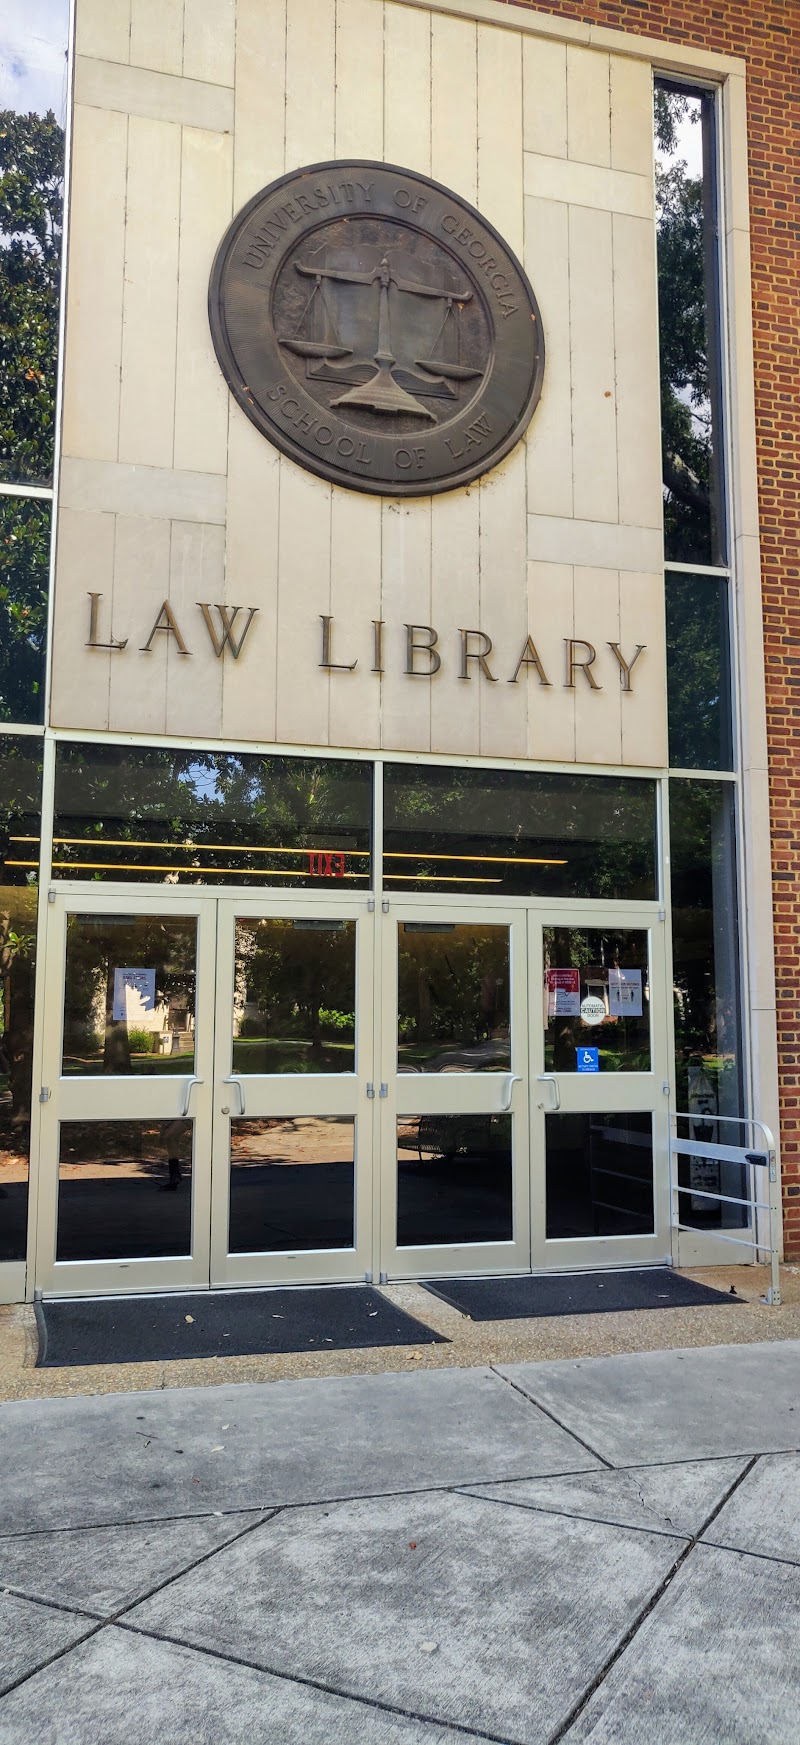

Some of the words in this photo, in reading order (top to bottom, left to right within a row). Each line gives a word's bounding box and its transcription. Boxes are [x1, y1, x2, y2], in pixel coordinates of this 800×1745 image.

[242, 181, 375, 269] UNIVERSITY
[393, 188, 428, 213] OF
[440, 213, 519, 320] GEORGIA
[266, 385, 372, 464] SCHOOL
[394, 446, 426, 469] OF
[444, 411, 494, 459] LAW
[85, 592, 260, 659] LAW
[318, 615, 647, 692] LIBRARY
